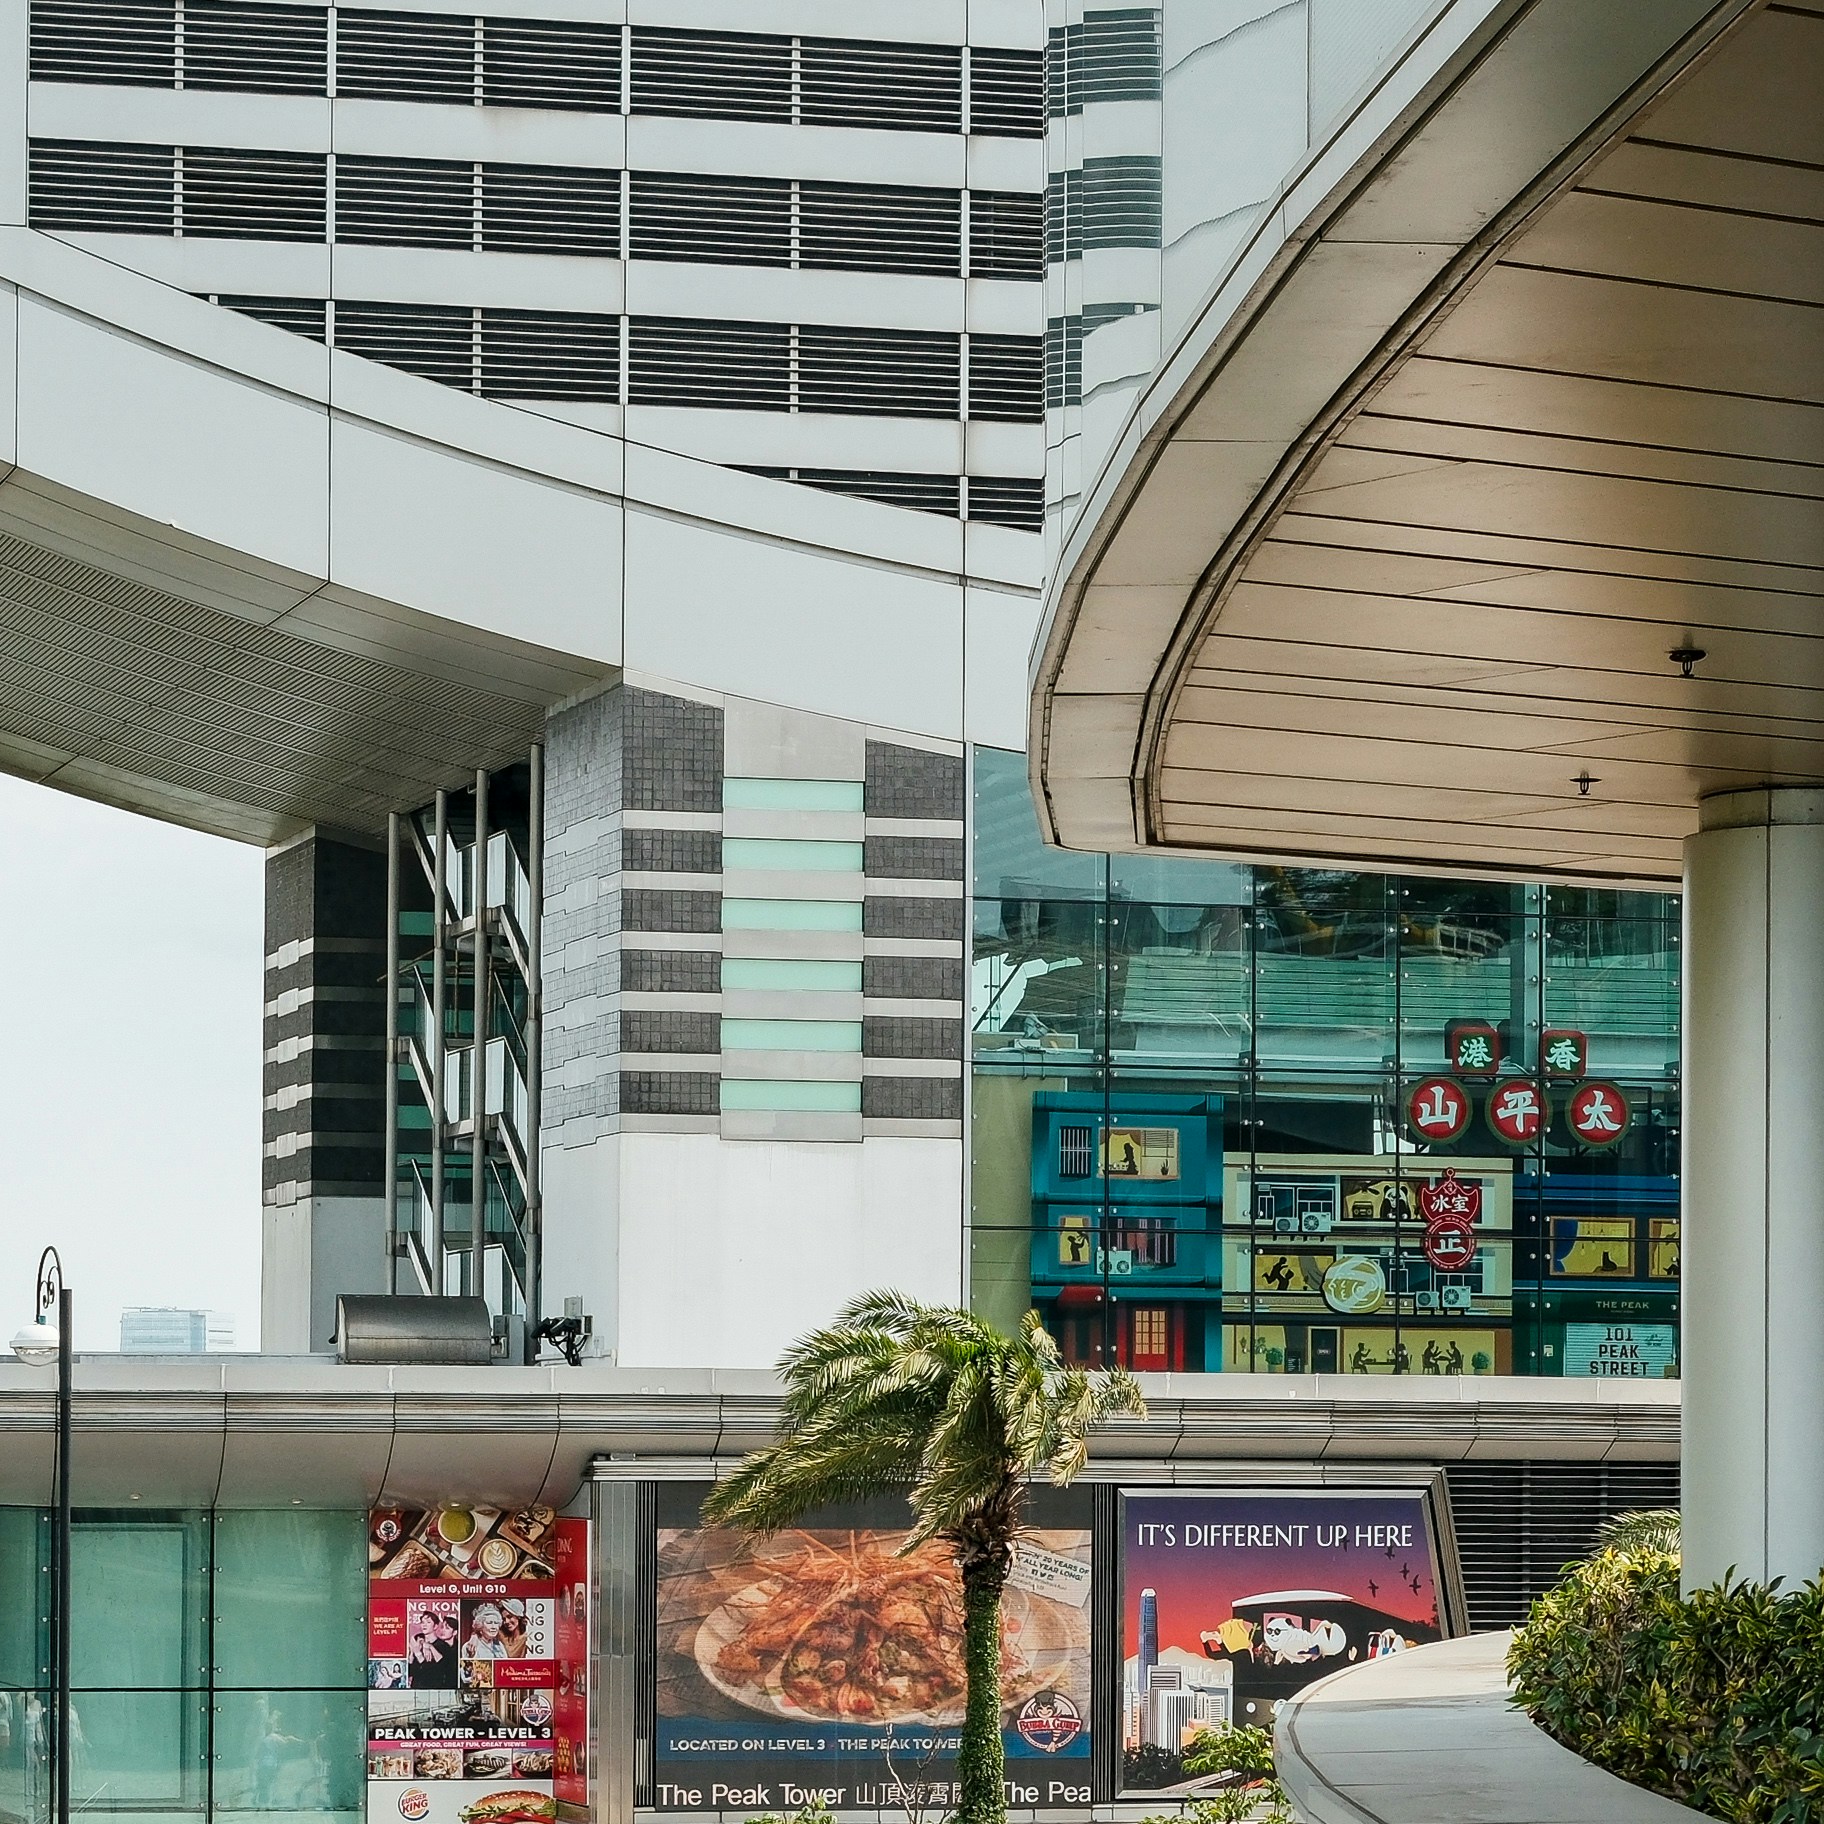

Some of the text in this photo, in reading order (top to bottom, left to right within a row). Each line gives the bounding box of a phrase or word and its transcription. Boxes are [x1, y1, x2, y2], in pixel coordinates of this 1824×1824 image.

[1430, 1194, 1470, 1213] 冰室
[1433, 1229, 1466, 1254] 正
[1596, 1300, 1650, 1309] THE PEAK
[1605, 1327, 1634, 1342] 101
[1598, 1344, 1640, 1359] PEAK
[1589, 1360, 1650, 1376] STREET
[1137, 1523, 1413, 1547] IT'S DIFFERENT UP HERE
[1023, 1558, 1038, 1566] ALL
[1039, 1563, 1059, 1573] YEAR
[1060, 1570, 1083, 1581] LONG!
[1042, 1555, 1053, 1563] 20
[1054, 1558, 1078, 1572] YEARS
[1078, 1567, 1090, 1575] OF
[419, 1584, 507, 1596] Level G, Unit G10
[409, 1602, 427, 1611] NG
[375, 1728, 416, 1740] PEAK
[421, 1728, 474, 1739] TOWER
[488, 1728, 537, 1739] LEVEL
[541, 1728, 551, 1739] 3
[669, 1739, 739, 1751] LOCATED
[741, 1739, 765, 1750] ON
[768, 1739, 815, 1750] LEVEL
[817, 1739, 826, 1750] 3
[838, 1739, 868, 1750] THE
[870, 1738, 910, 1750] PEAK
[402, 1792, 428, 1806] BURGER
[656, 1783, 703, 1806] The
[711, 1783, 771, 1806] Peak
[778, 1783, 847, 1806] Tower
[402, 1799, 429, 1814] KING
